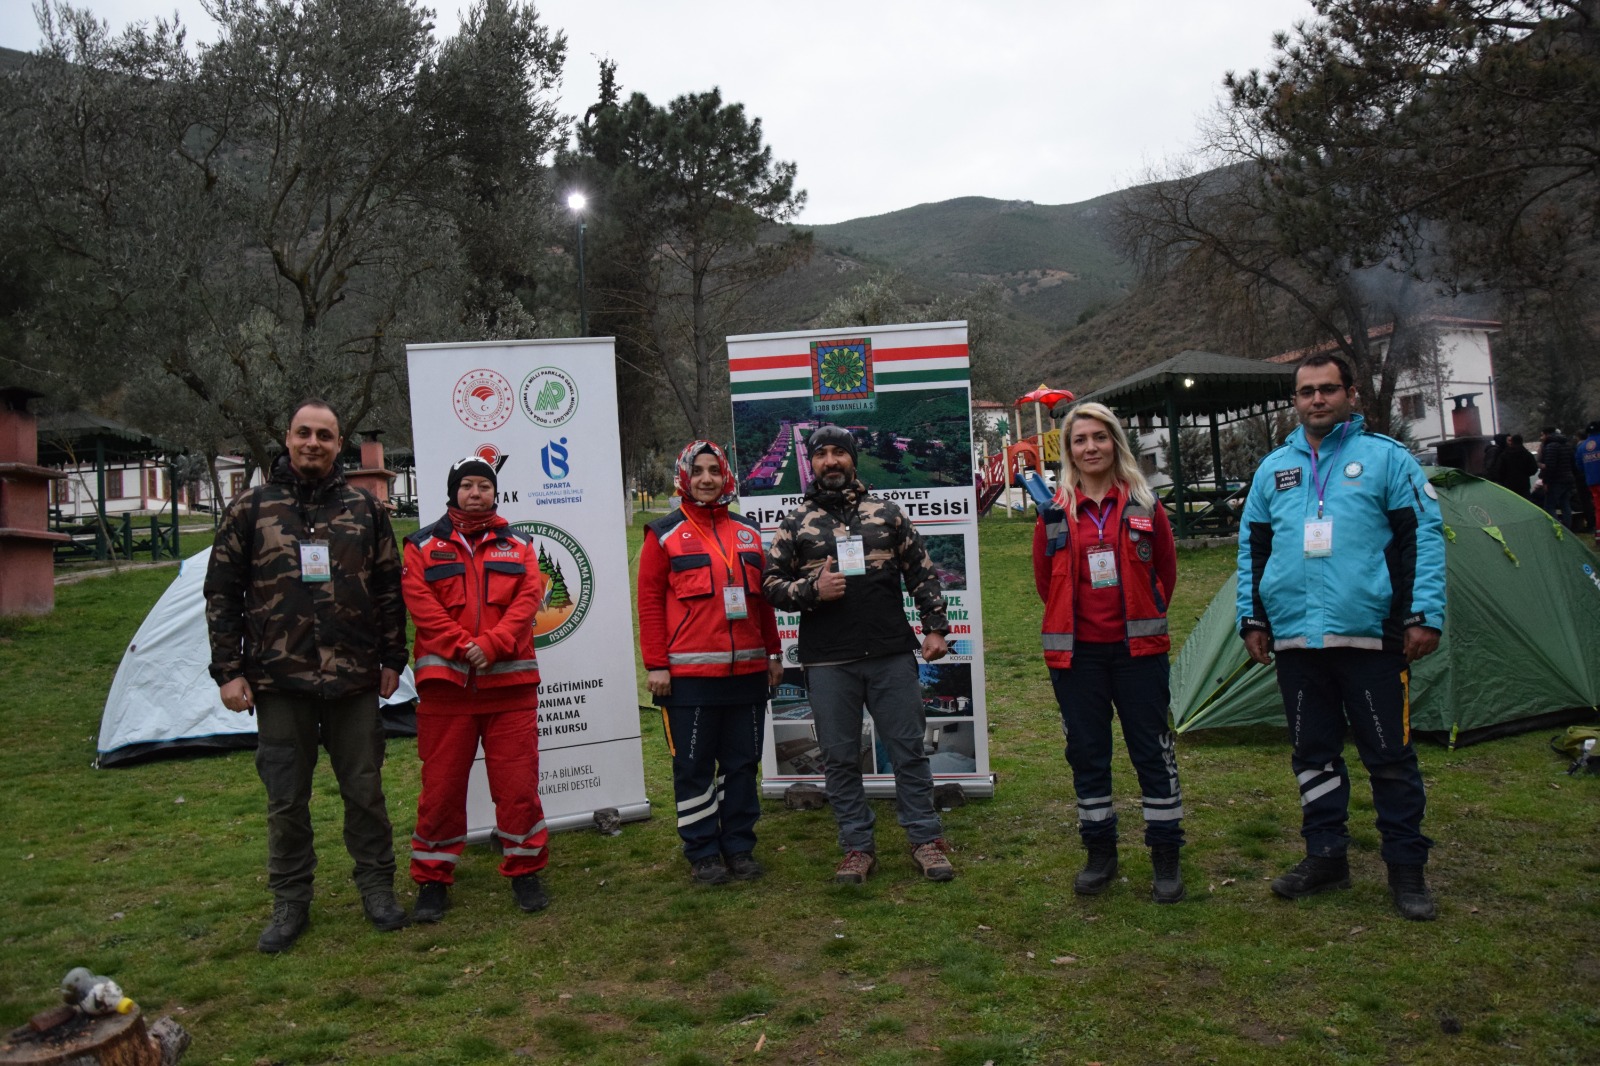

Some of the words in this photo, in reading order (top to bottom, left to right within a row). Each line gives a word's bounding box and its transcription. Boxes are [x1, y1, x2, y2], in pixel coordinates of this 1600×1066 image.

[543, 482, 571, 490] ISPARTA
[536, 495, 582, 506] ÜNİVERSİTESİ
[883, 490, 930, 500] SÖYLET
[904, 498, 969, 516] TESİSİ
[537, 525, 548, 534] VE
[548, 529, 577, 553] HAYATTA
[574, 550, 590, 578] KALMA
[549, 622, 574, 642] KURSU
[547, 679, 604, 694] EĞİTİMİNDE
[574, 695, 586, 704] VE
[546, 710, 580, 720] KALMA
[555, 722, 588, 734] KURSU
[560, 765, 594, 778] BİLİMSEL
[570, 776, 601, 791] DESTEĞİ
